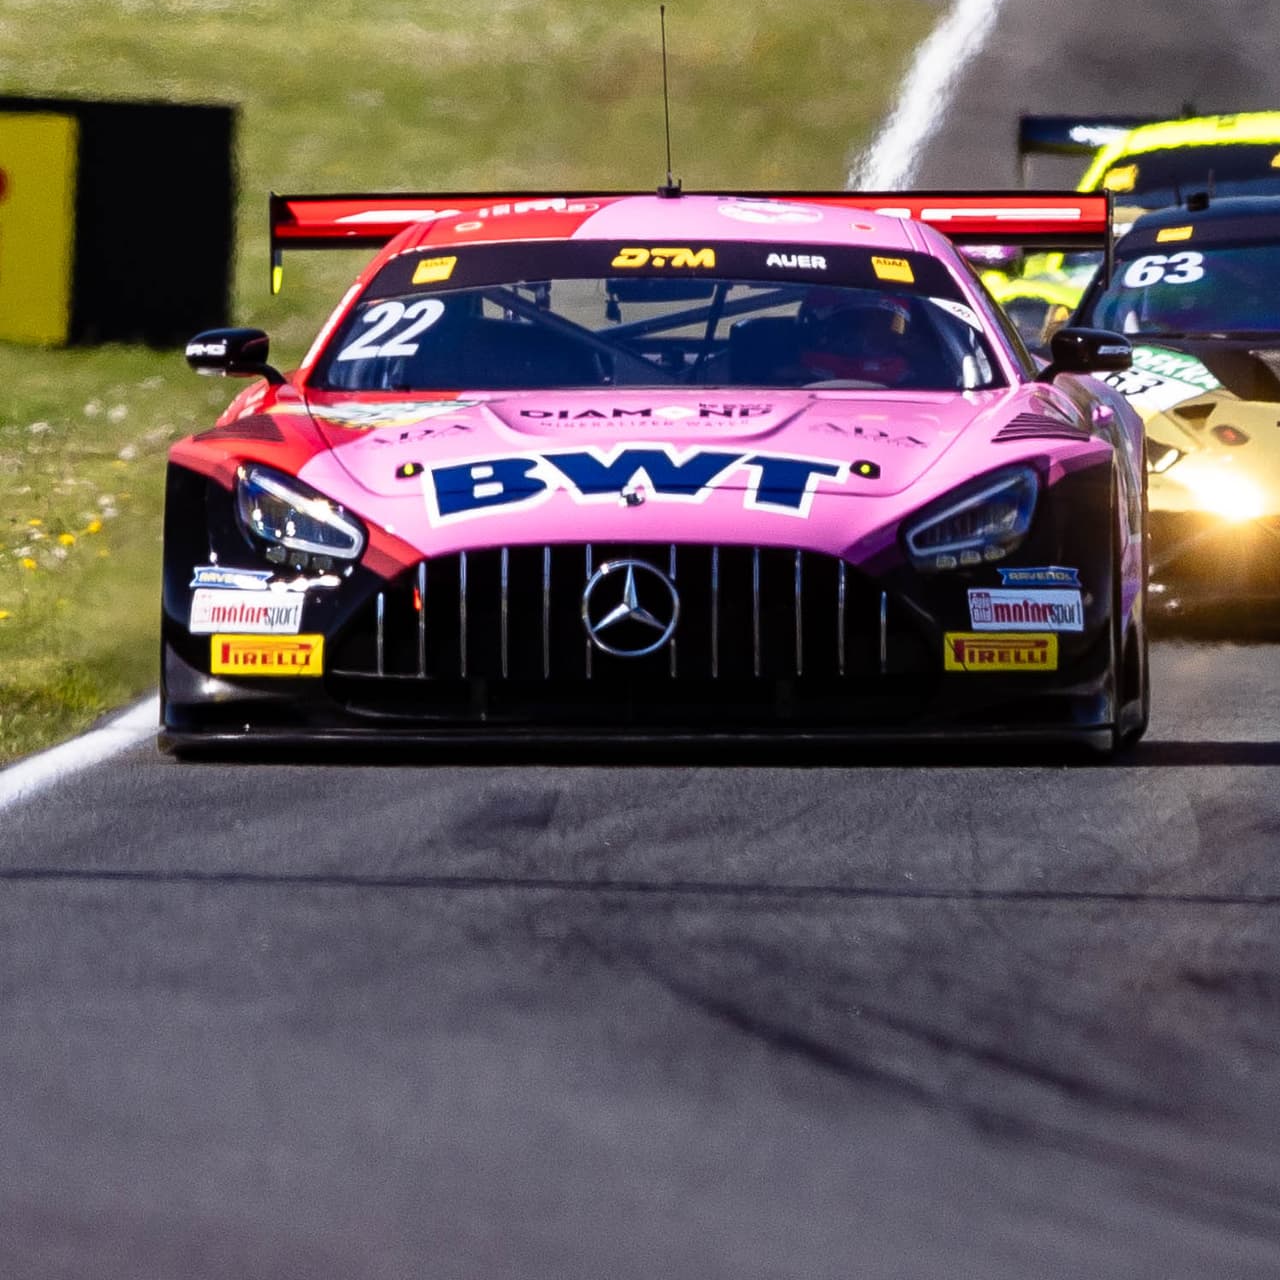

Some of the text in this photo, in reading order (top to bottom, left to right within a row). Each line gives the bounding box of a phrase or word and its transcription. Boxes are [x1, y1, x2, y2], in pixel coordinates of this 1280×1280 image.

[611, 247, 716, 268] DTM
[766, 253, 827, 270] AUER
[1123, 252, 1205, 289] 63
[338, 299, 445, 361] 22
[428, 445, 846, 523] BWT
[210, 603, 299, 628] motorsport
[994, 600, 1082, 625] motorsport
[221, 642, 312, 666] PIRELLI
[954, 638, 1049, 665] PIRELLI
